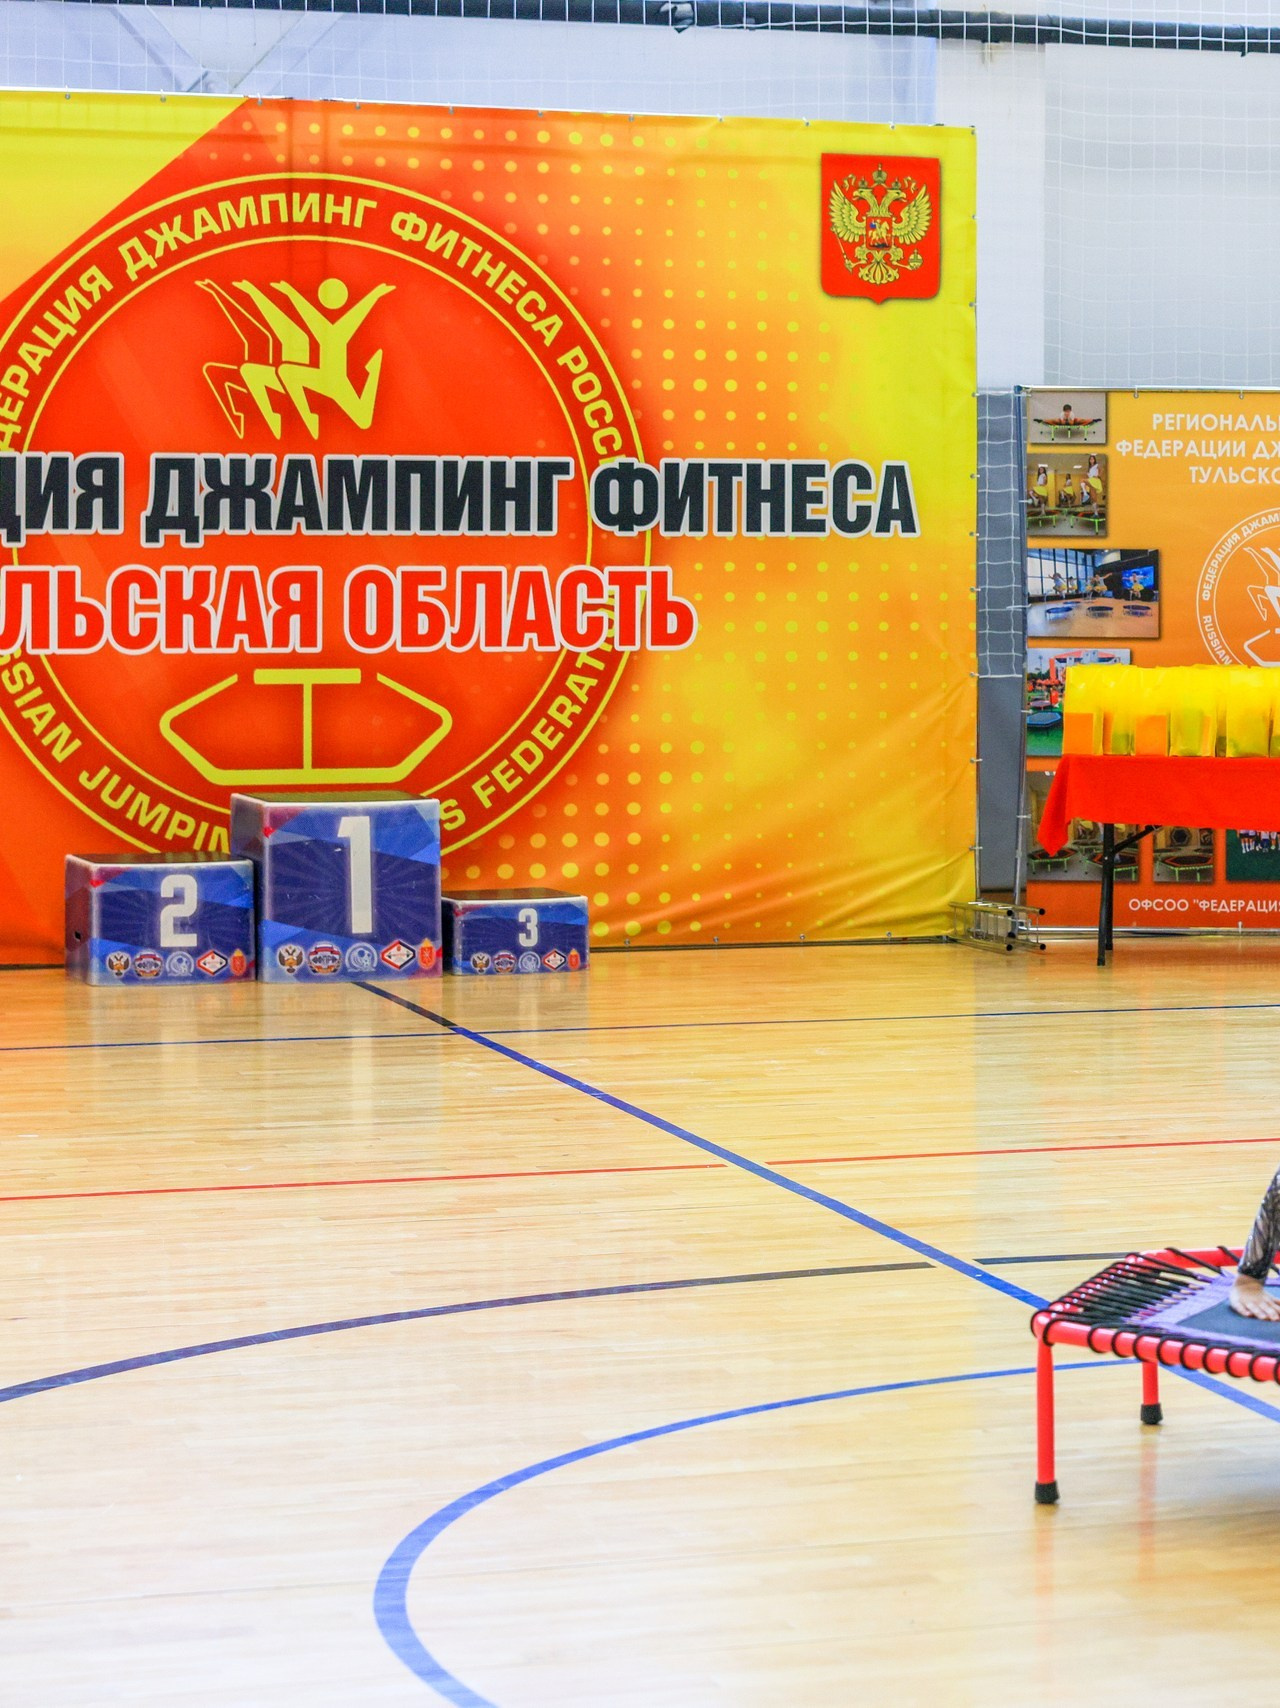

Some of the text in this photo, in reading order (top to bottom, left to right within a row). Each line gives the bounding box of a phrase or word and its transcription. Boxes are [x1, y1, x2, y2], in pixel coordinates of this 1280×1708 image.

[118, 192, 378, 282] ДЖАМПИНГ
[390, 211, 564, 347] ФИТНЕСА
[556, 345, 626, 465] РОСС
[1116, 439, 1246, 459] ФЕДЕРАЦИИ
[142, 454, 573, 546] ДЖАМПИНГ
[591, 459, 920, 538] ФИТНЕСА
[1202, 533, 1241, 601] ФЕДЕРАЦИЯ
[345, 565, 697, 653] ОБЛАСТЬ
[1202, 615, 1233, 665] RUSSIAN
[471, 590, 616, 809] FEDERAT
[160, 874, 198, 947] 2
[337, 815, 373, 934] 1
[1128, 898, 1189, 912] ОФСОО
[518, 907, 539, 947] 3
